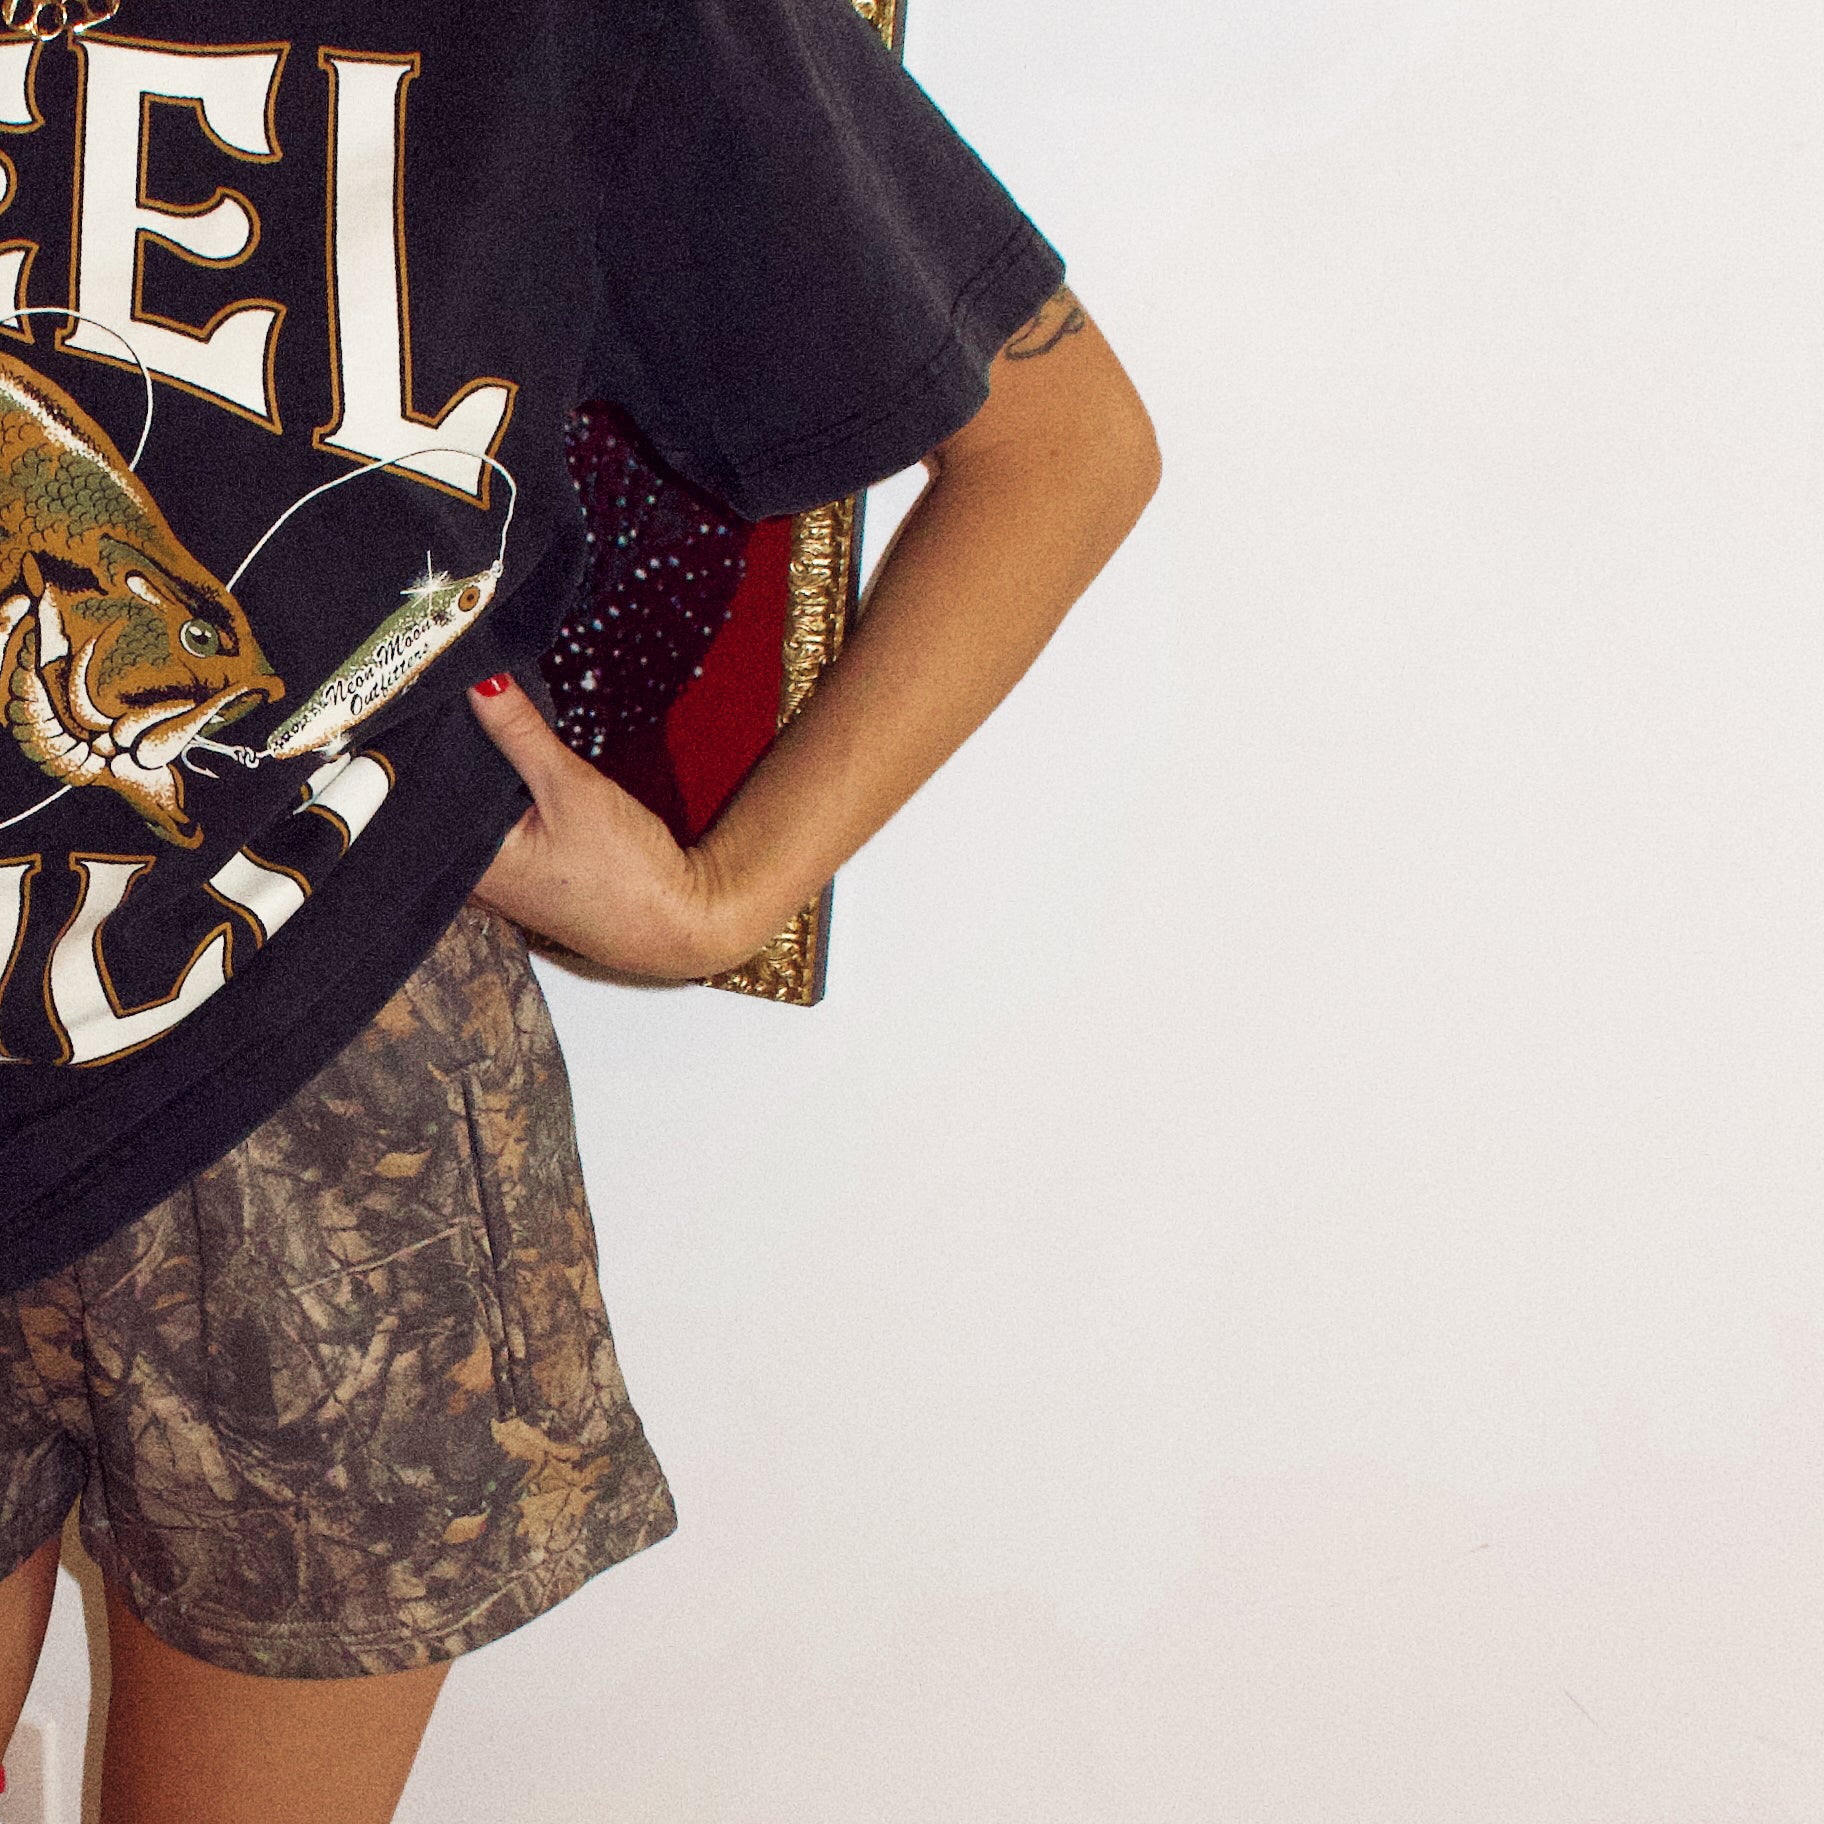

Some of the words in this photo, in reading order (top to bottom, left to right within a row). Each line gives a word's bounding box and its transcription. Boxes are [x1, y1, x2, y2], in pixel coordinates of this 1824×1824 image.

[324, 666, 376, 707] Neon
[376, 619, 431, 666] Moon
[349, 642, 429, 717] Outfitters
